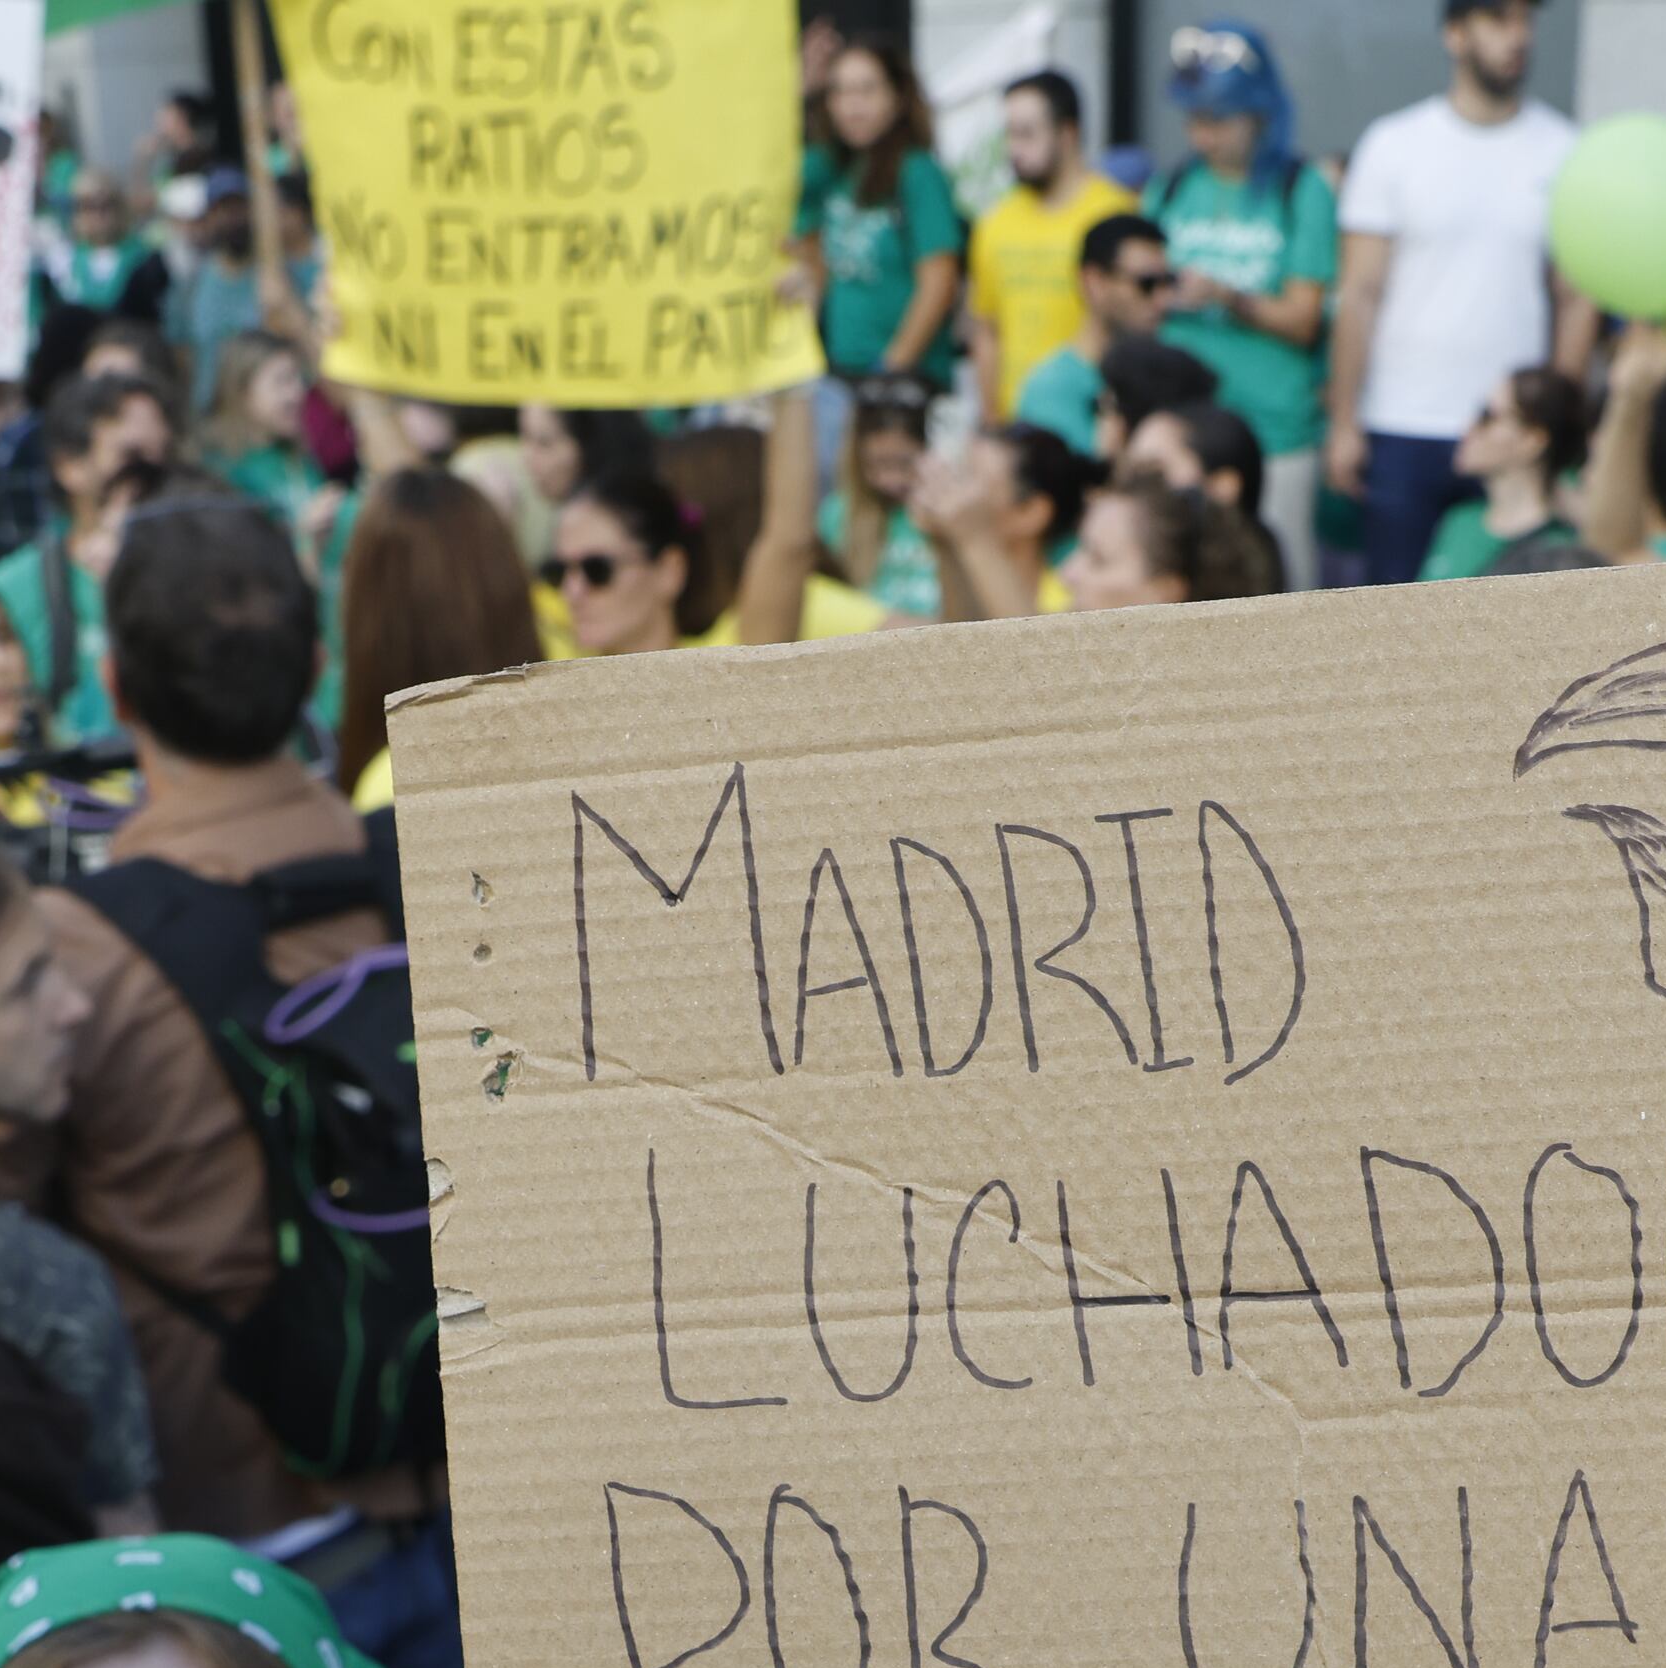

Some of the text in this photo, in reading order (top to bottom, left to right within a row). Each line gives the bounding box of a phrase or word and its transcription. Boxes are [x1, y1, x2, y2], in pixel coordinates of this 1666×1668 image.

[451, 0, 675, 97] ESTAS
[409, 103, 648, 200] RATIOS
[332, 193, 408, 282] NO
[425, 195, 773, 287] ENTRAMOS
[371, 302, 439, 376] NI
[559, 298, 623, 378] EL
[572, 760, 1307, 1087] MADRID
